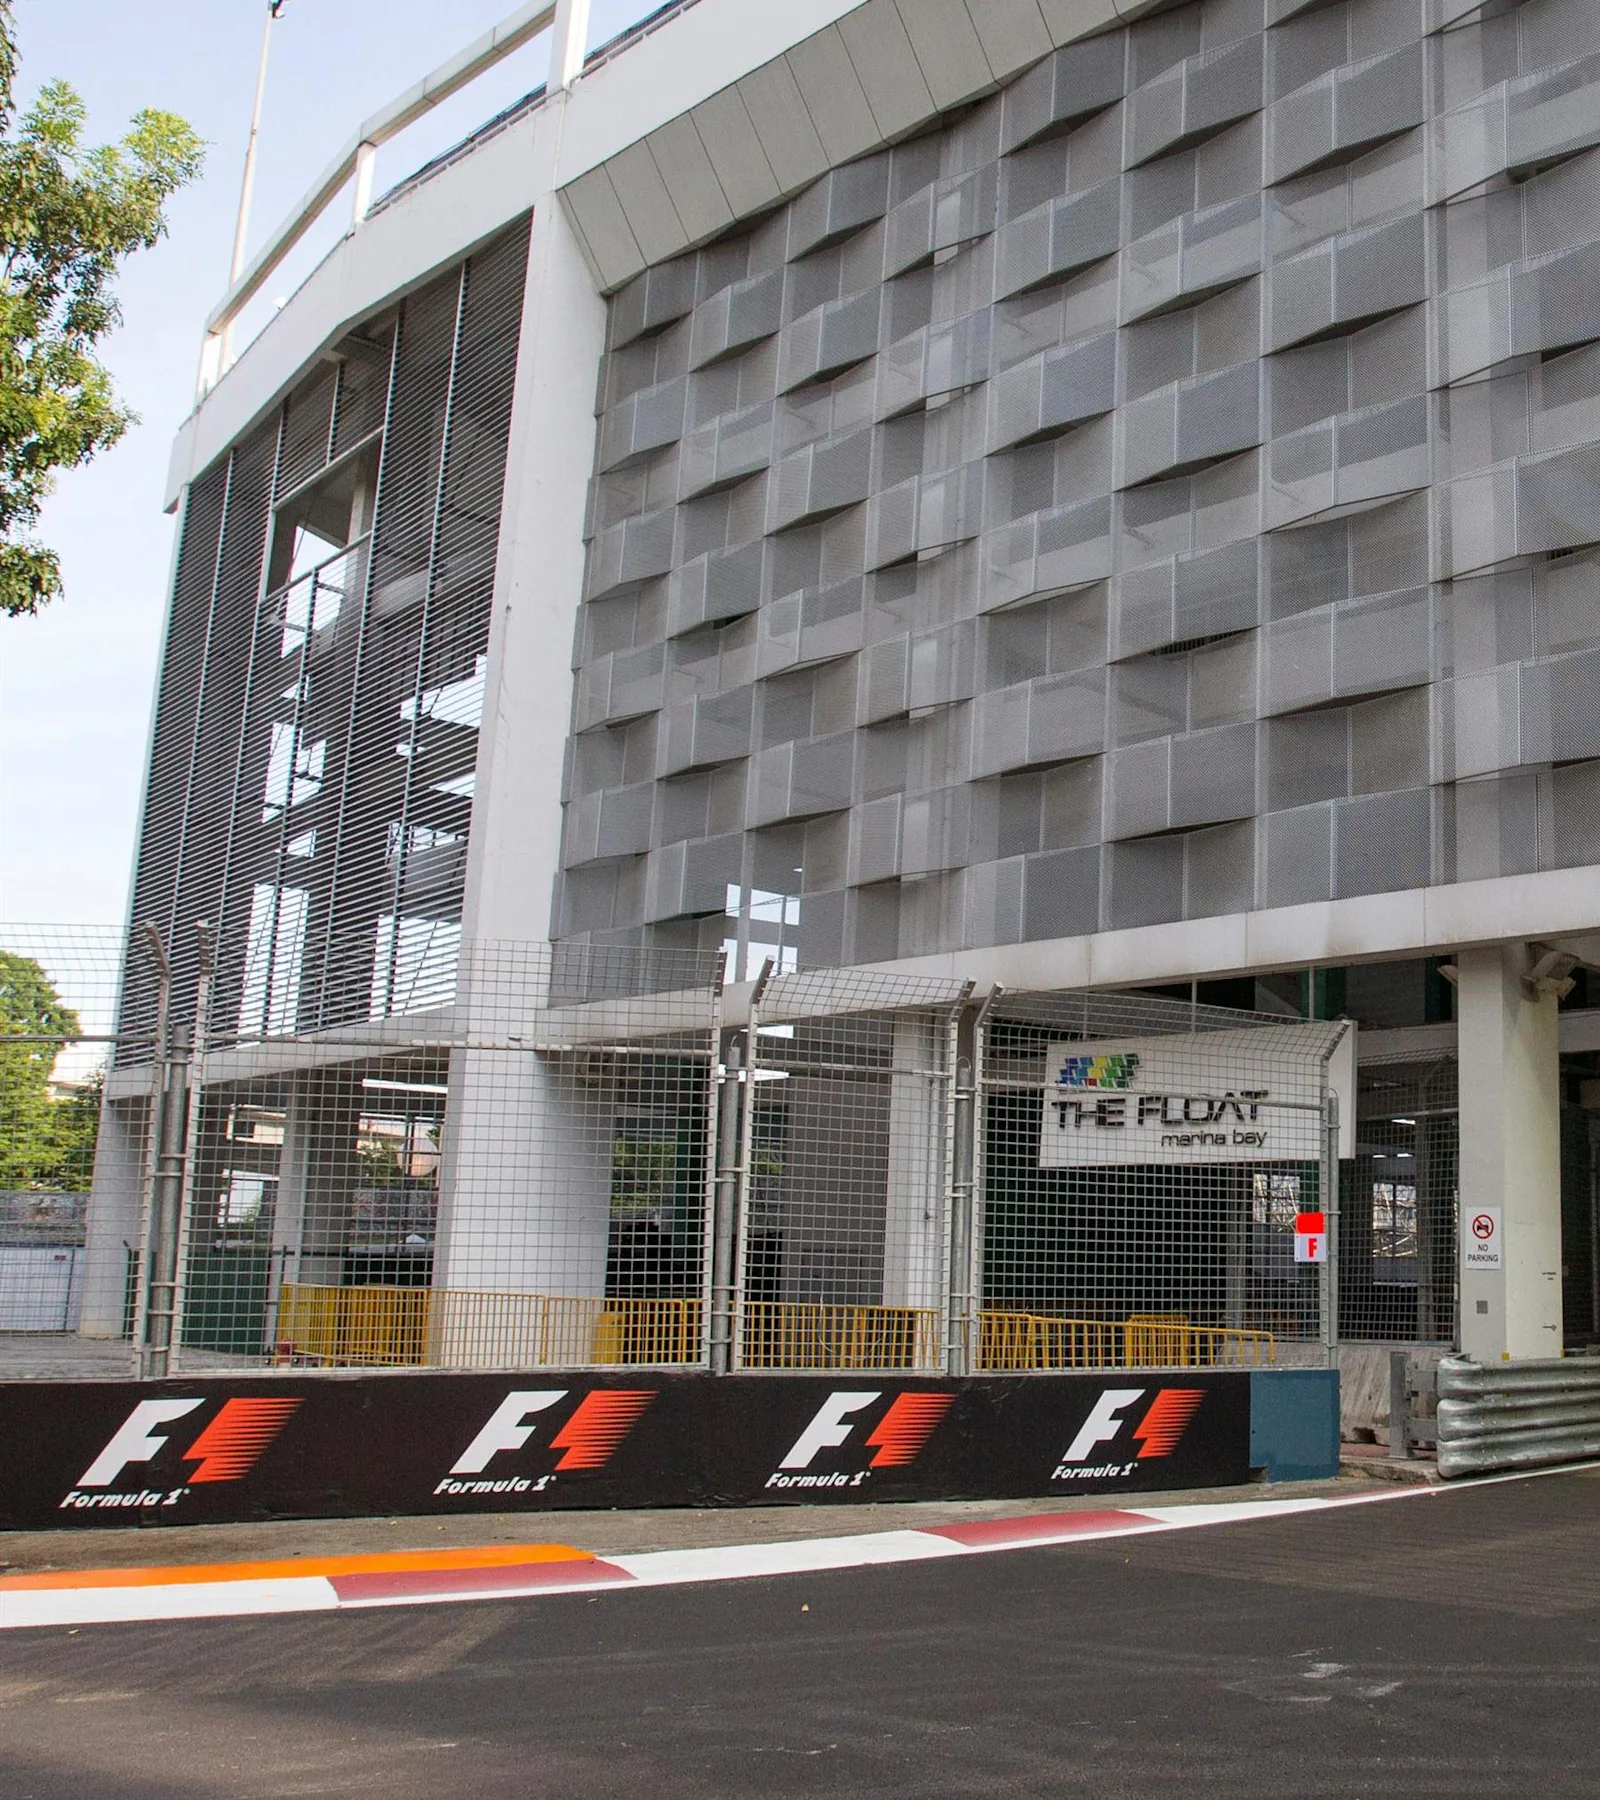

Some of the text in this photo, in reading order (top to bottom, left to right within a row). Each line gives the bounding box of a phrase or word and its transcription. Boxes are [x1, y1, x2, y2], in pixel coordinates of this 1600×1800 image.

[1051, 1090, 1269, 1128] THE FLOAT
[1161, 1129, 1268, 1148] marina bay
[1308, 1238, 1318, 1258] F
[1467, 1254, 1499, 1262] PARKING
[449, 1390, 660, 1474] F1
[778, 1391, 959, 1469] F1
[1062, 1389, 1208, 1462] F1
[76, 1398, 306, 1487] F1
[764, 1471, 849, 1488] Formula
[1051, 1463, 1121, 1479] Formula
[433, 1476, 527, 1494] Formula
[58, 1490, 162, 1508] Formula
